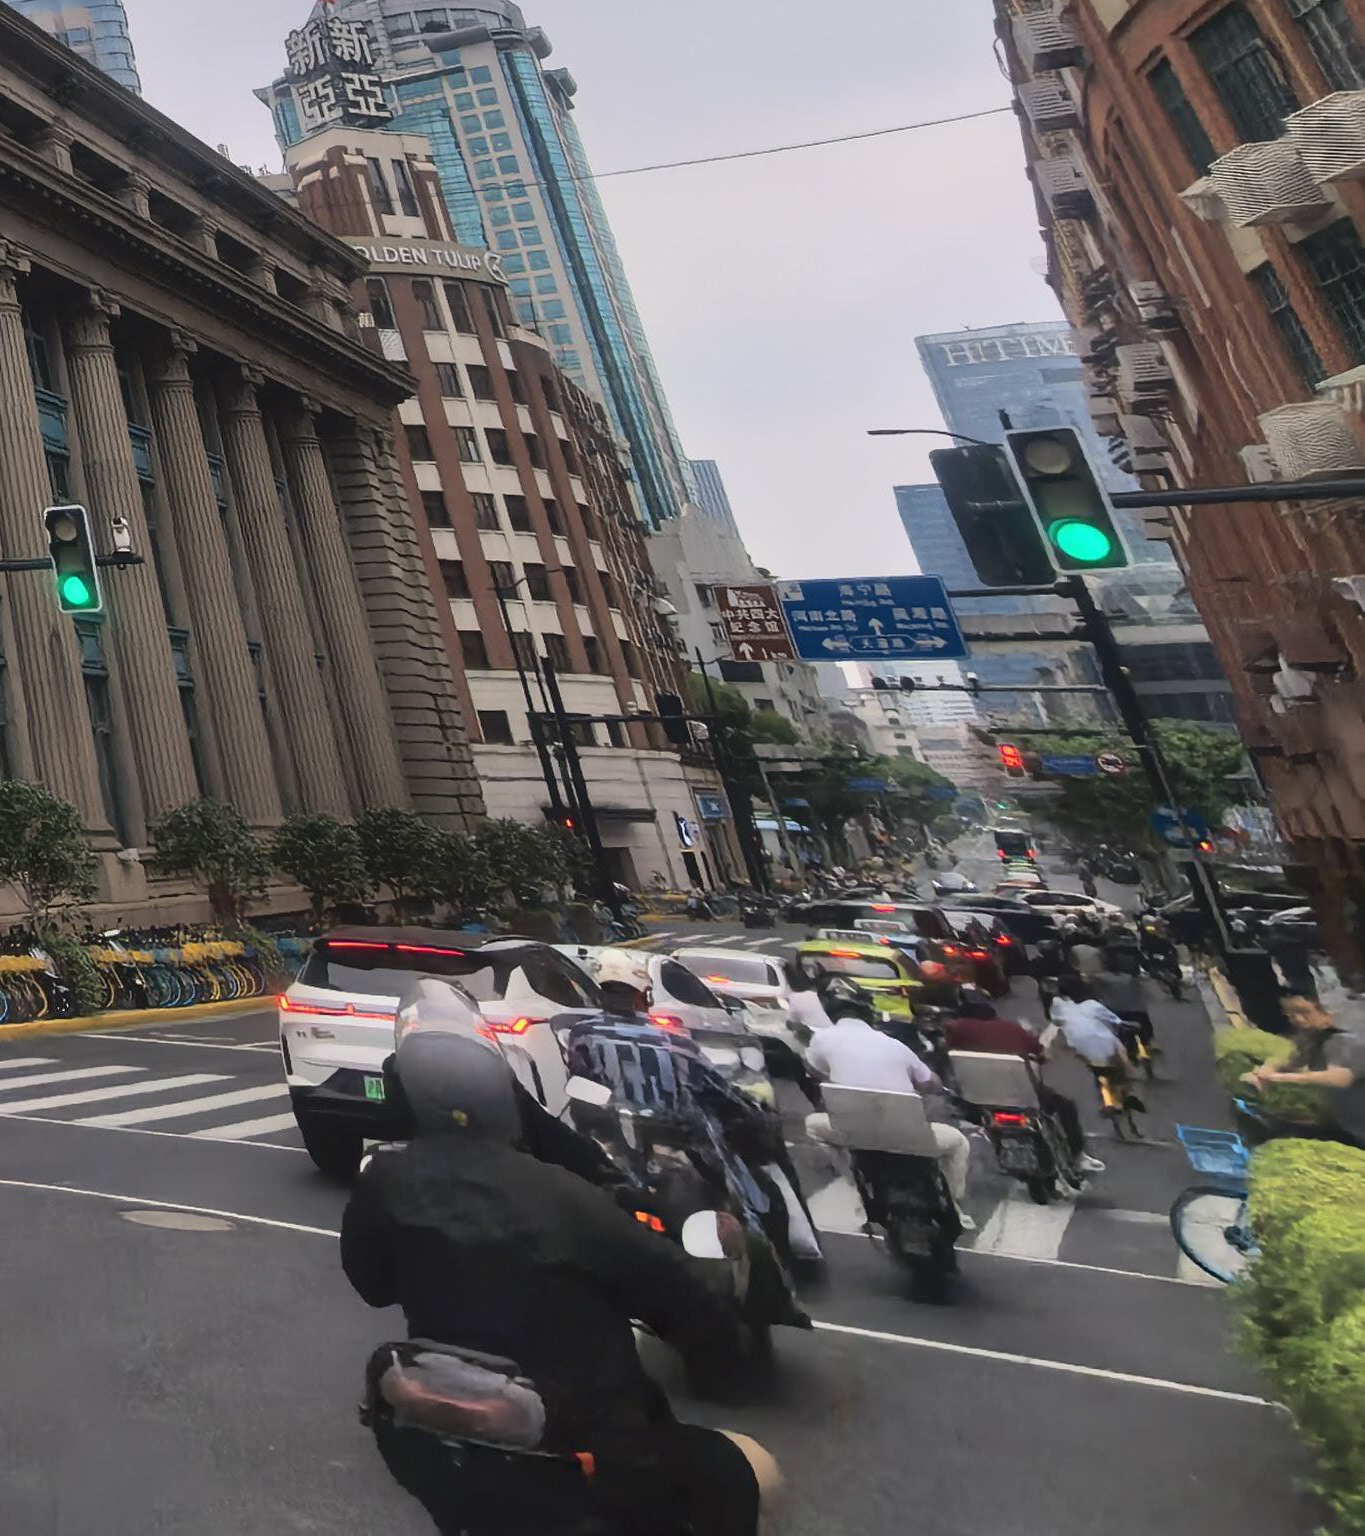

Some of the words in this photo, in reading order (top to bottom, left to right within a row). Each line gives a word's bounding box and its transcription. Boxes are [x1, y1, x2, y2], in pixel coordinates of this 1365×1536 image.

[431, 249, 481, 272] TULIP
[722, 608, 780, 621] 中共四大
